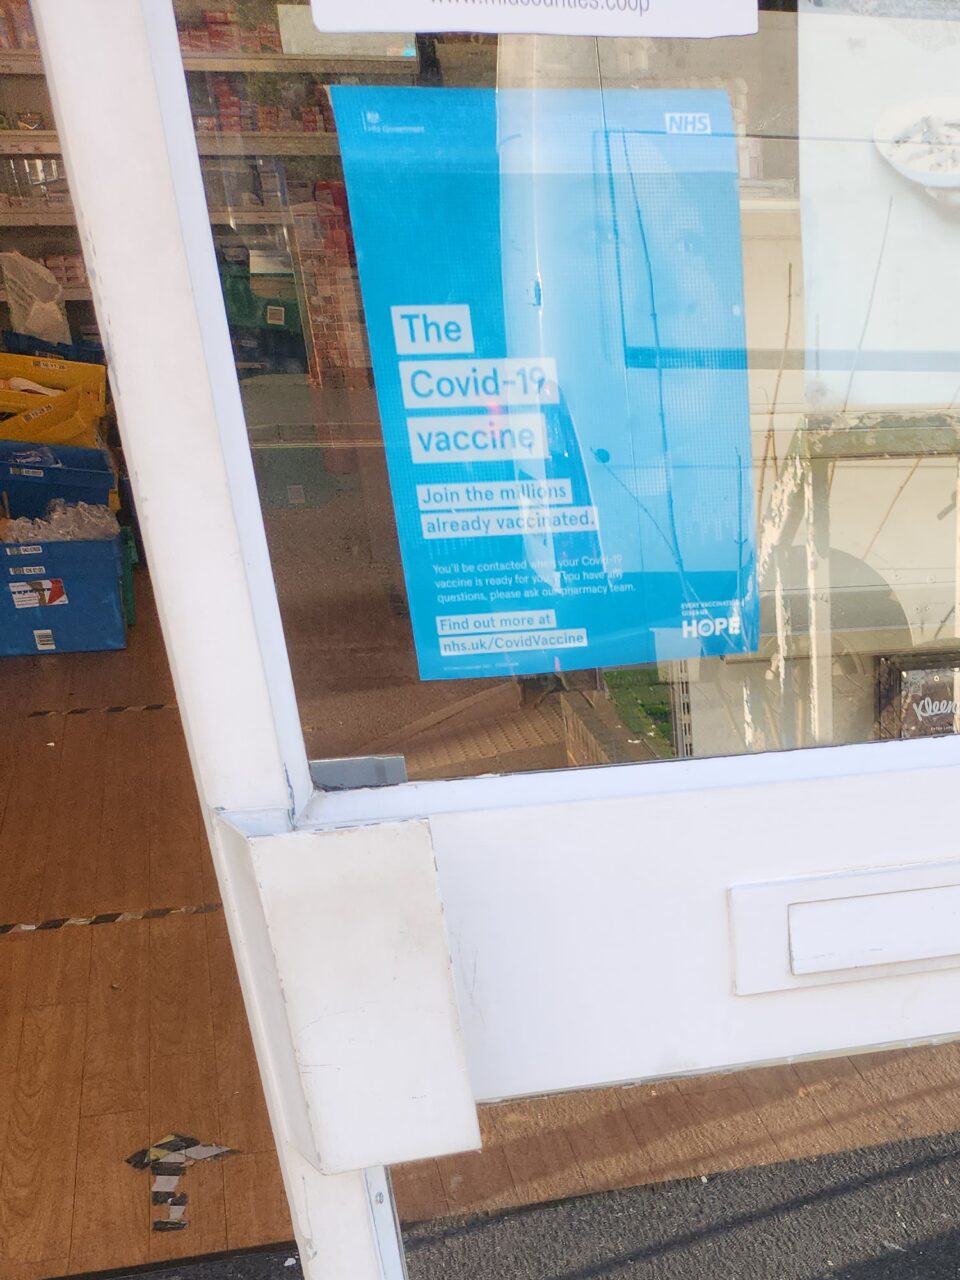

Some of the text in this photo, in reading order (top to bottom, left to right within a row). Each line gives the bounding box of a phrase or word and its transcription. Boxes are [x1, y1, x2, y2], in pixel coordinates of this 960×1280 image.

[668, 115, 709, 132] NHS
[400, 313, 463, 343] The
[409, 365, 546, 399] Covid-19
[416, 421, 536, 453] vaccine
[422, 483, 567, 504] Join the millions
[426, 510, 596, 535] already vaccinated.
[461, 562, 475, 573] be
[476, 560, 528, 572] contacted
[434, 578, 473, 589] vaccine
[475, 576, 484, 587] is
[485, 574, 513, 587] ready
[514, 573, 529, 585] for
[531, 573, 550, 586] you
[582, 569, 605, 581] have
[437, 591, 488, 605] questions,
[489, 588, 522, 602] please
[524, 587, 540, 598] ask
[560, 582, 608, 598] pharmacy
[439, 613, 552, 631] Find out more at
[681, 617, 741, 639] HOPE
[442, 633, 585, 653] nhs.uk/CovidVaccine
